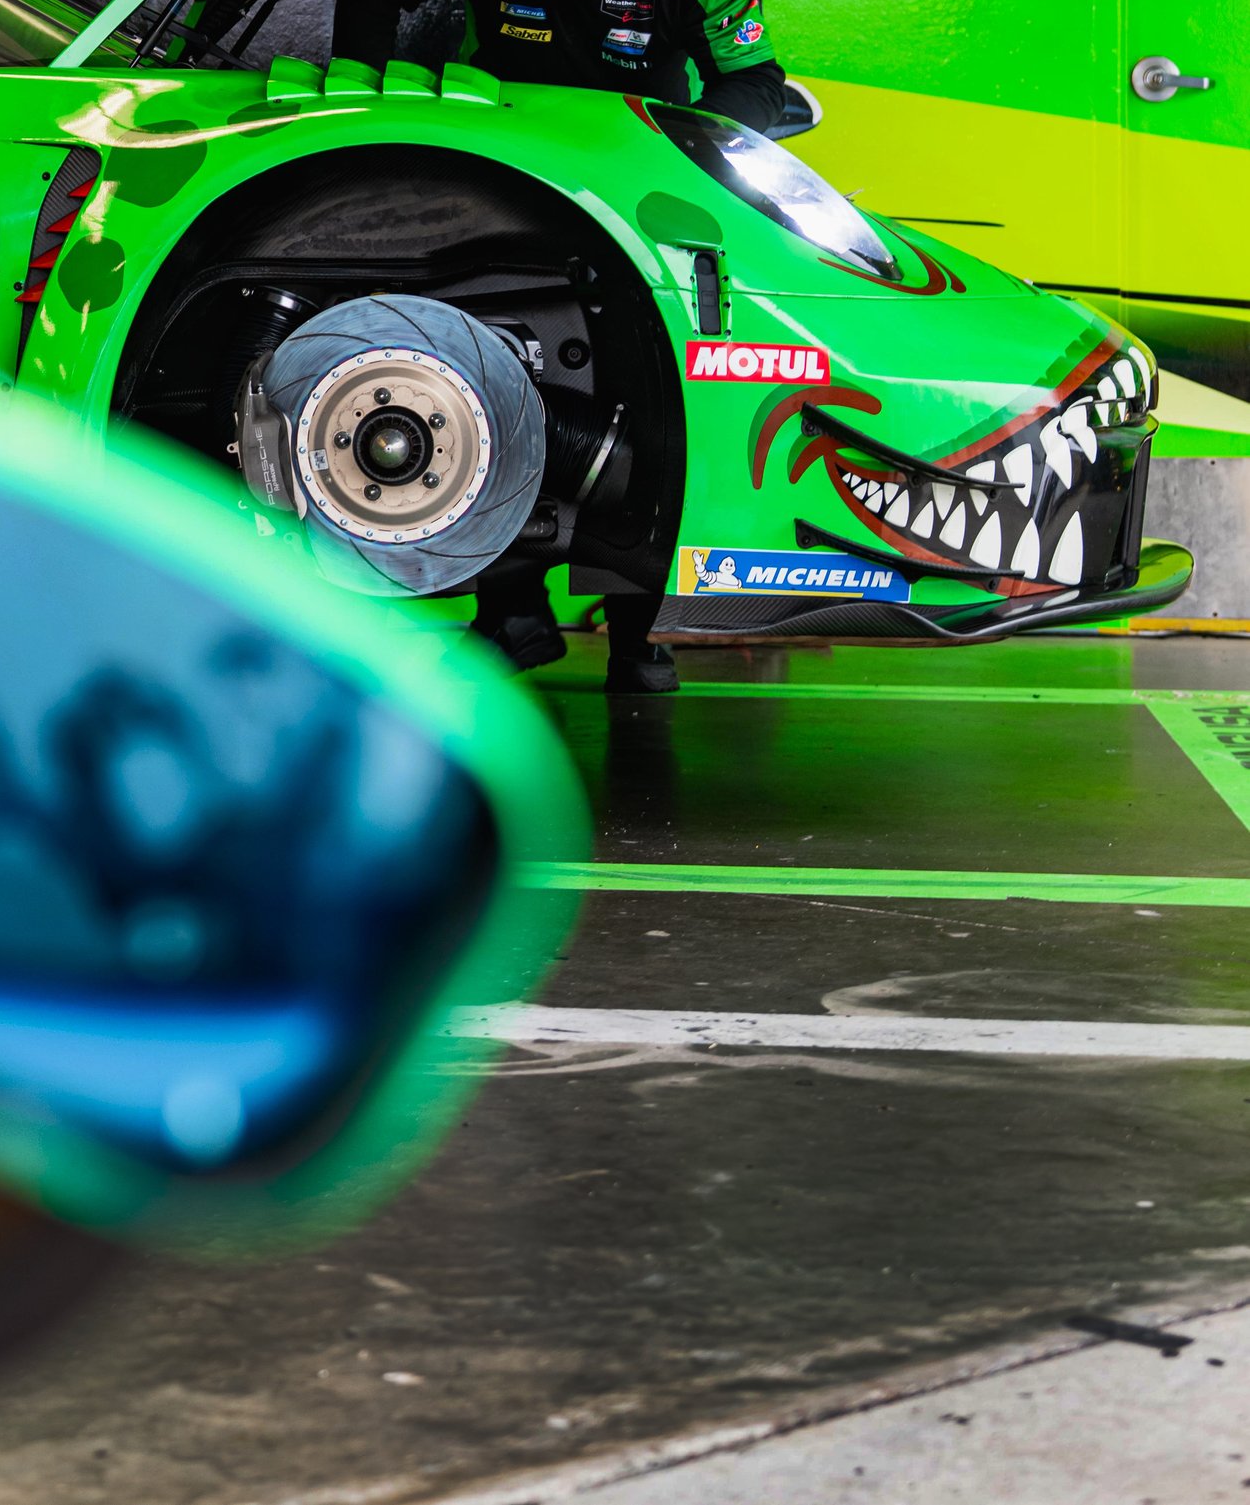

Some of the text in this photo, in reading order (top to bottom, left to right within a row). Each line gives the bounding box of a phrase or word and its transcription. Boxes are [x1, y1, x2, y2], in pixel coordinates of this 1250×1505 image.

[506, 26, 548, 41] Sabelt
[692, 346, 825, 380] MOTUL
[254, 426, 276, 506] PORSCHE
[746, 566, 894, 589] MICHELIN
